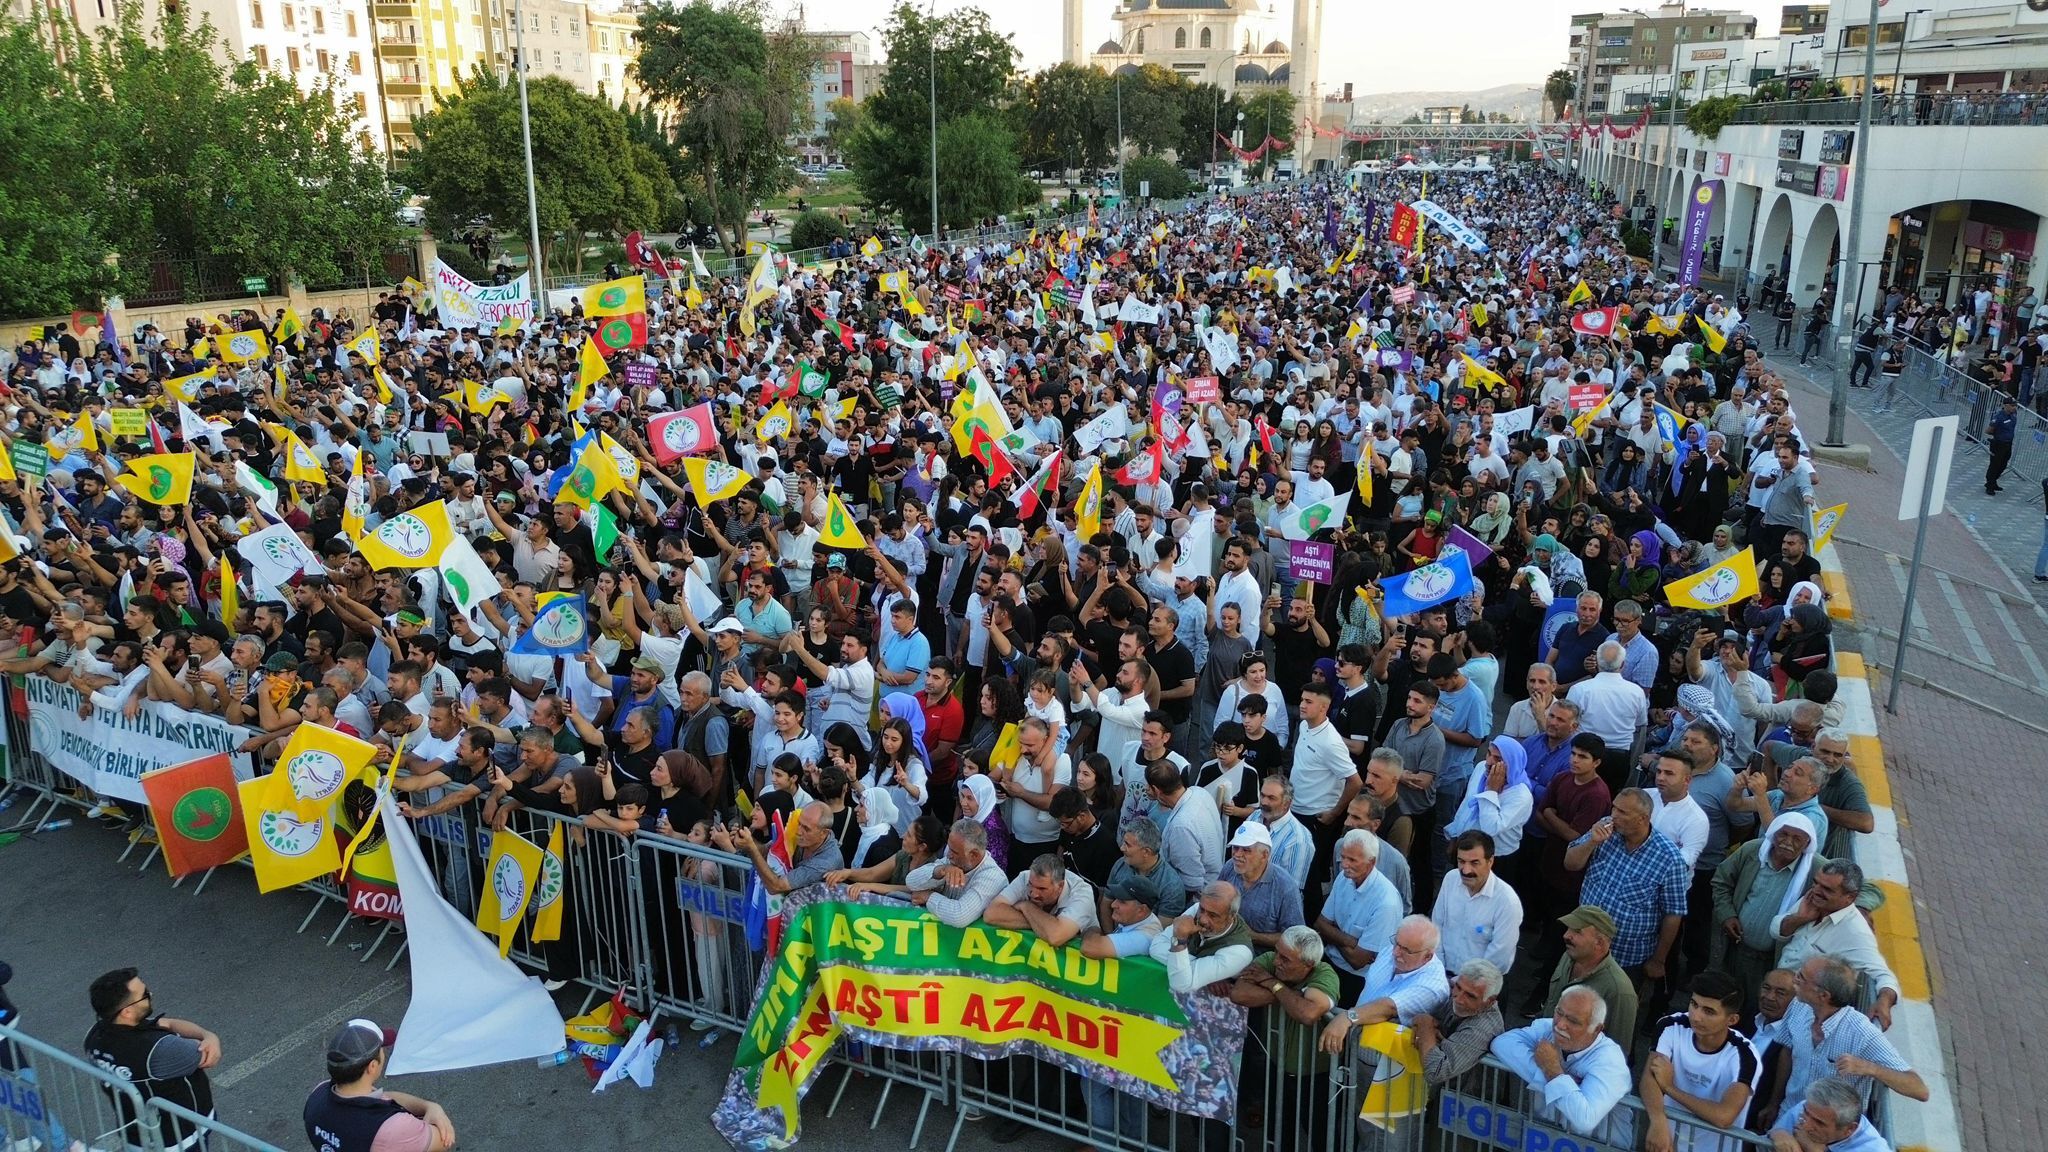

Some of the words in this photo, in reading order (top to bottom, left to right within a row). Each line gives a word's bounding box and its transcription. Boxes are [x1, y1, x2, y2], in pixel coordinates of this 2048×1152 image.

[1304, 545, 1319, 557] AŞTİ
[1298, 568, 1315, 579] AZAD
[1316, 572, 1323, 580] E!
[827, 912, 944, 961] AŞTÎ
[835, 978, 945, 1027] AŞTÎ
[960, 992, 1124, 1060] AZADÎ
